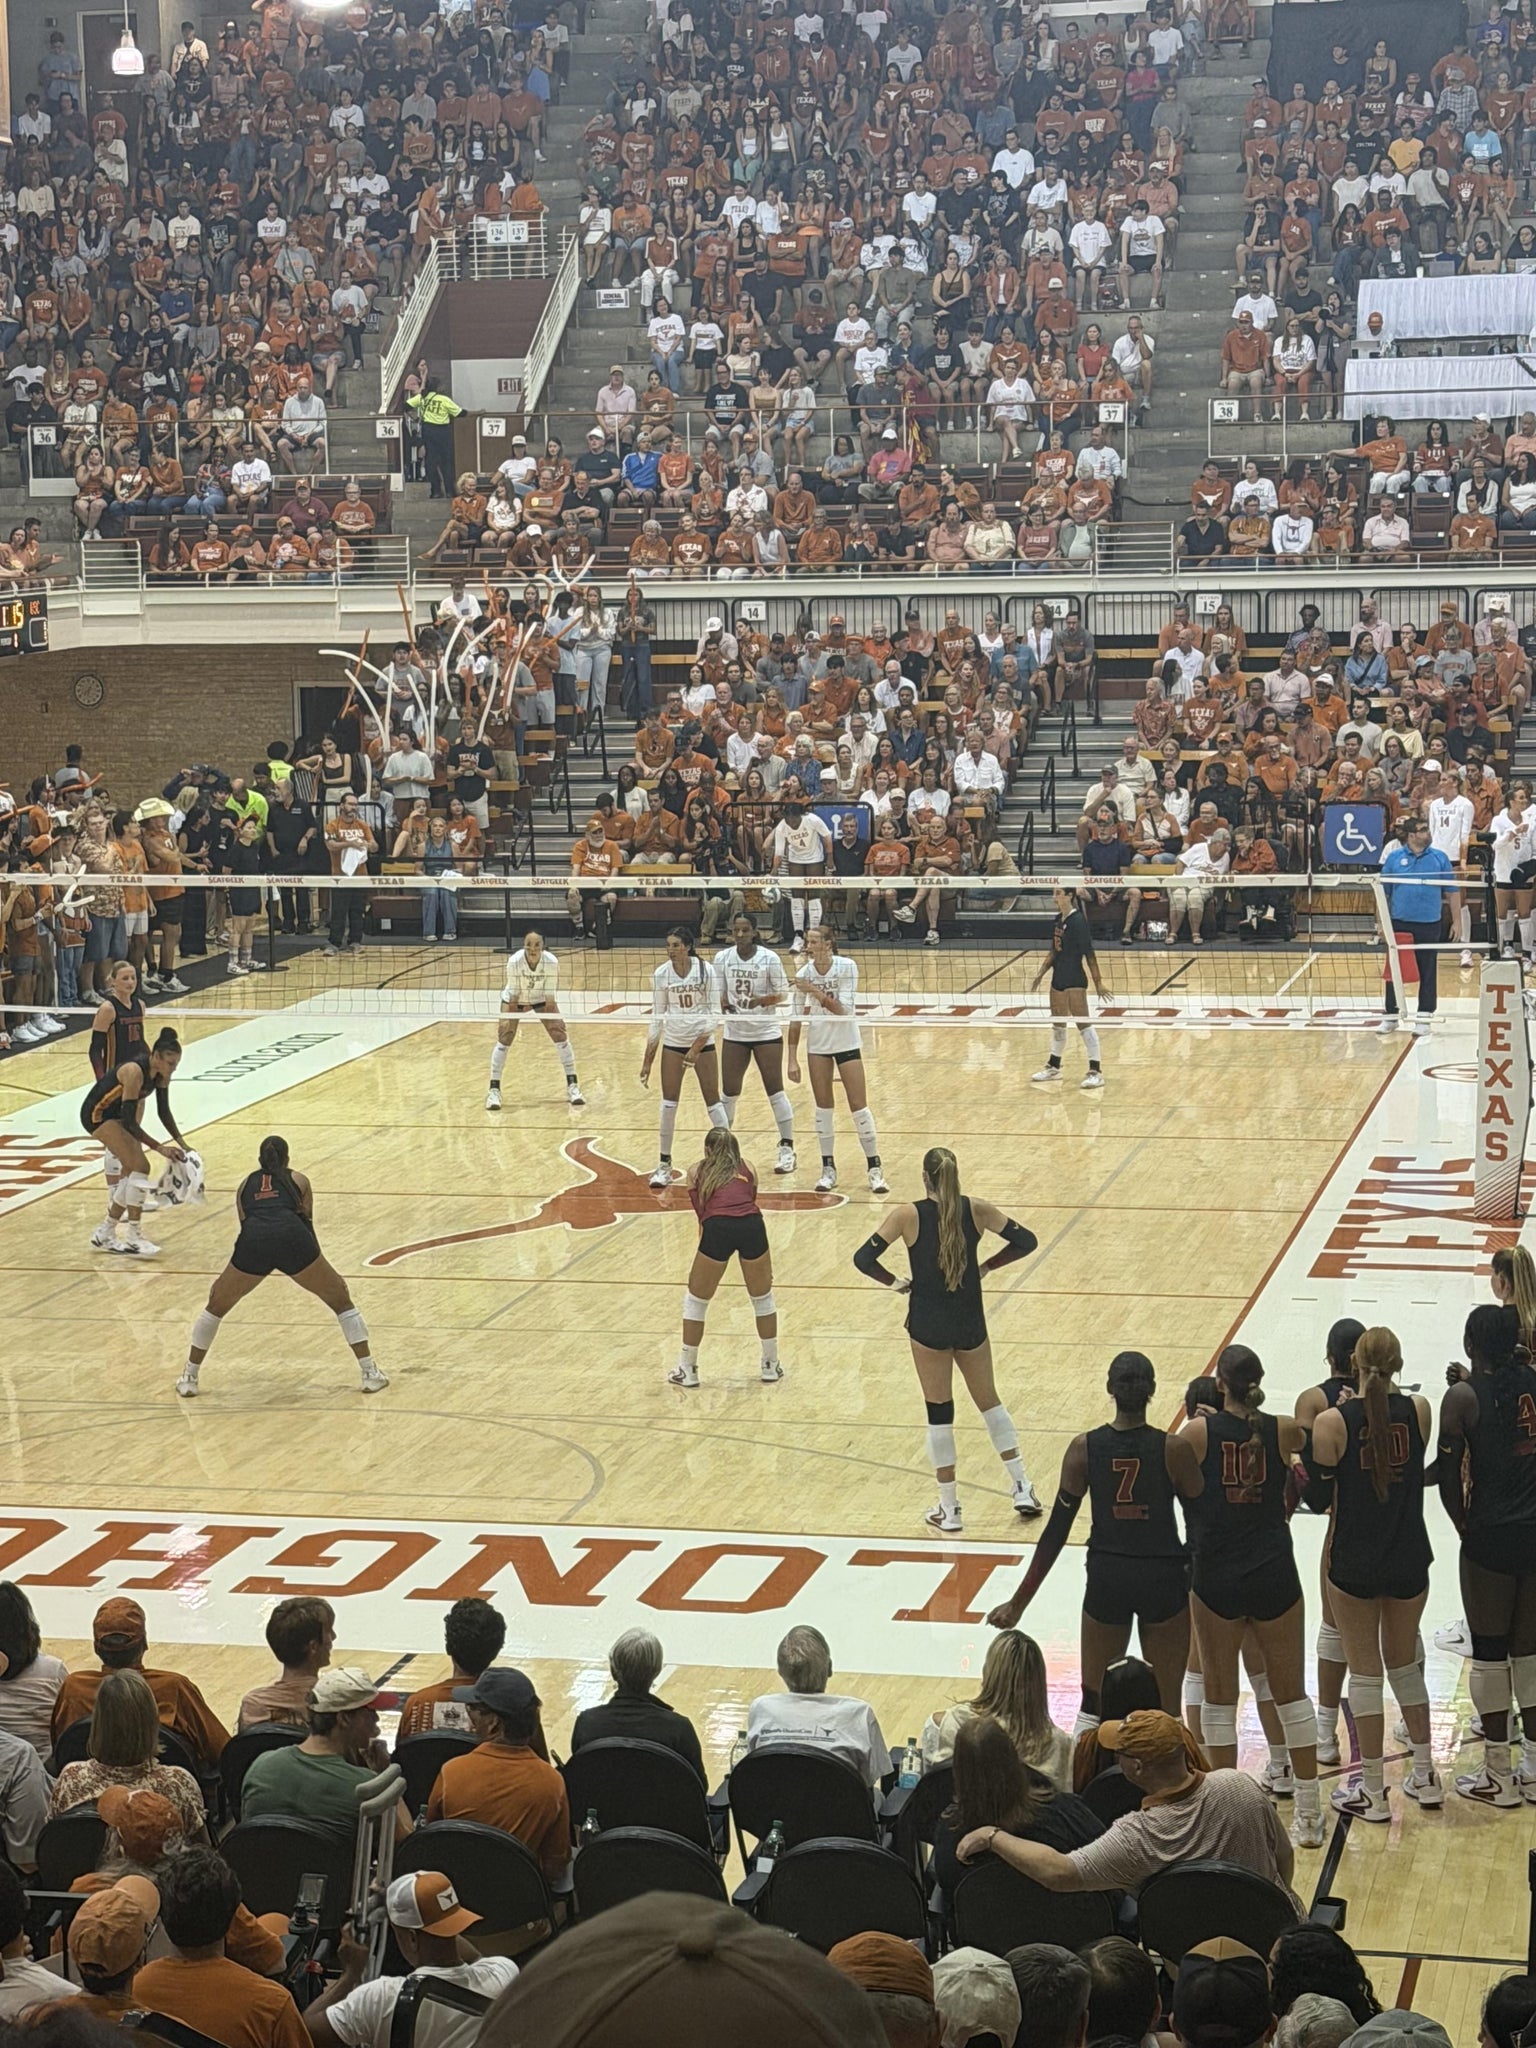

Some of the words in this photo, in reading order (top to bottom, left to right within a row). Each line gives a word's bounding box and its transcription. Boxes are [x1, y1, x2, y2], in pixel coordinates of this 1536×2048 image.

[666, 176, 688, 187] TEXAS
[513, 227, 526, 236] 137
[502, 379, 521, 392] EXIT
[1105, 410, 1118, 420] 37
[1220, 407, 1233, 417] 38
[382, 426, 394, 436] 36
[488, 425, 500, 435] 37
[39, 433, 51, 443] 36
[1203, 601, 1215, 613] 15
[748, 608, 759, 618] 14
[1189, 708, 1214, 717] TEXAS
[1440, 816, 1450, 828] 14
[338, 829, 364, 838] TEXAS
[790, 834, 809, 843] TEXAS
[110, 876, 143, 884] TEXAS
[1198, 876, 1235, 884] TEXAS
[732, 970, 758, 980] TEXAS
[672, 984, 700, 993] TEXAS
[736, 980, 752, 993] 23
[679, 994, 693, 1009] 10
[1482, 984, 1515, 1161] TEXAS
[261, 1174, 272, 1191] 1
[1222, 1441, 1266, 1486] 10
[1112, 1458, 1140, 1502] 7
